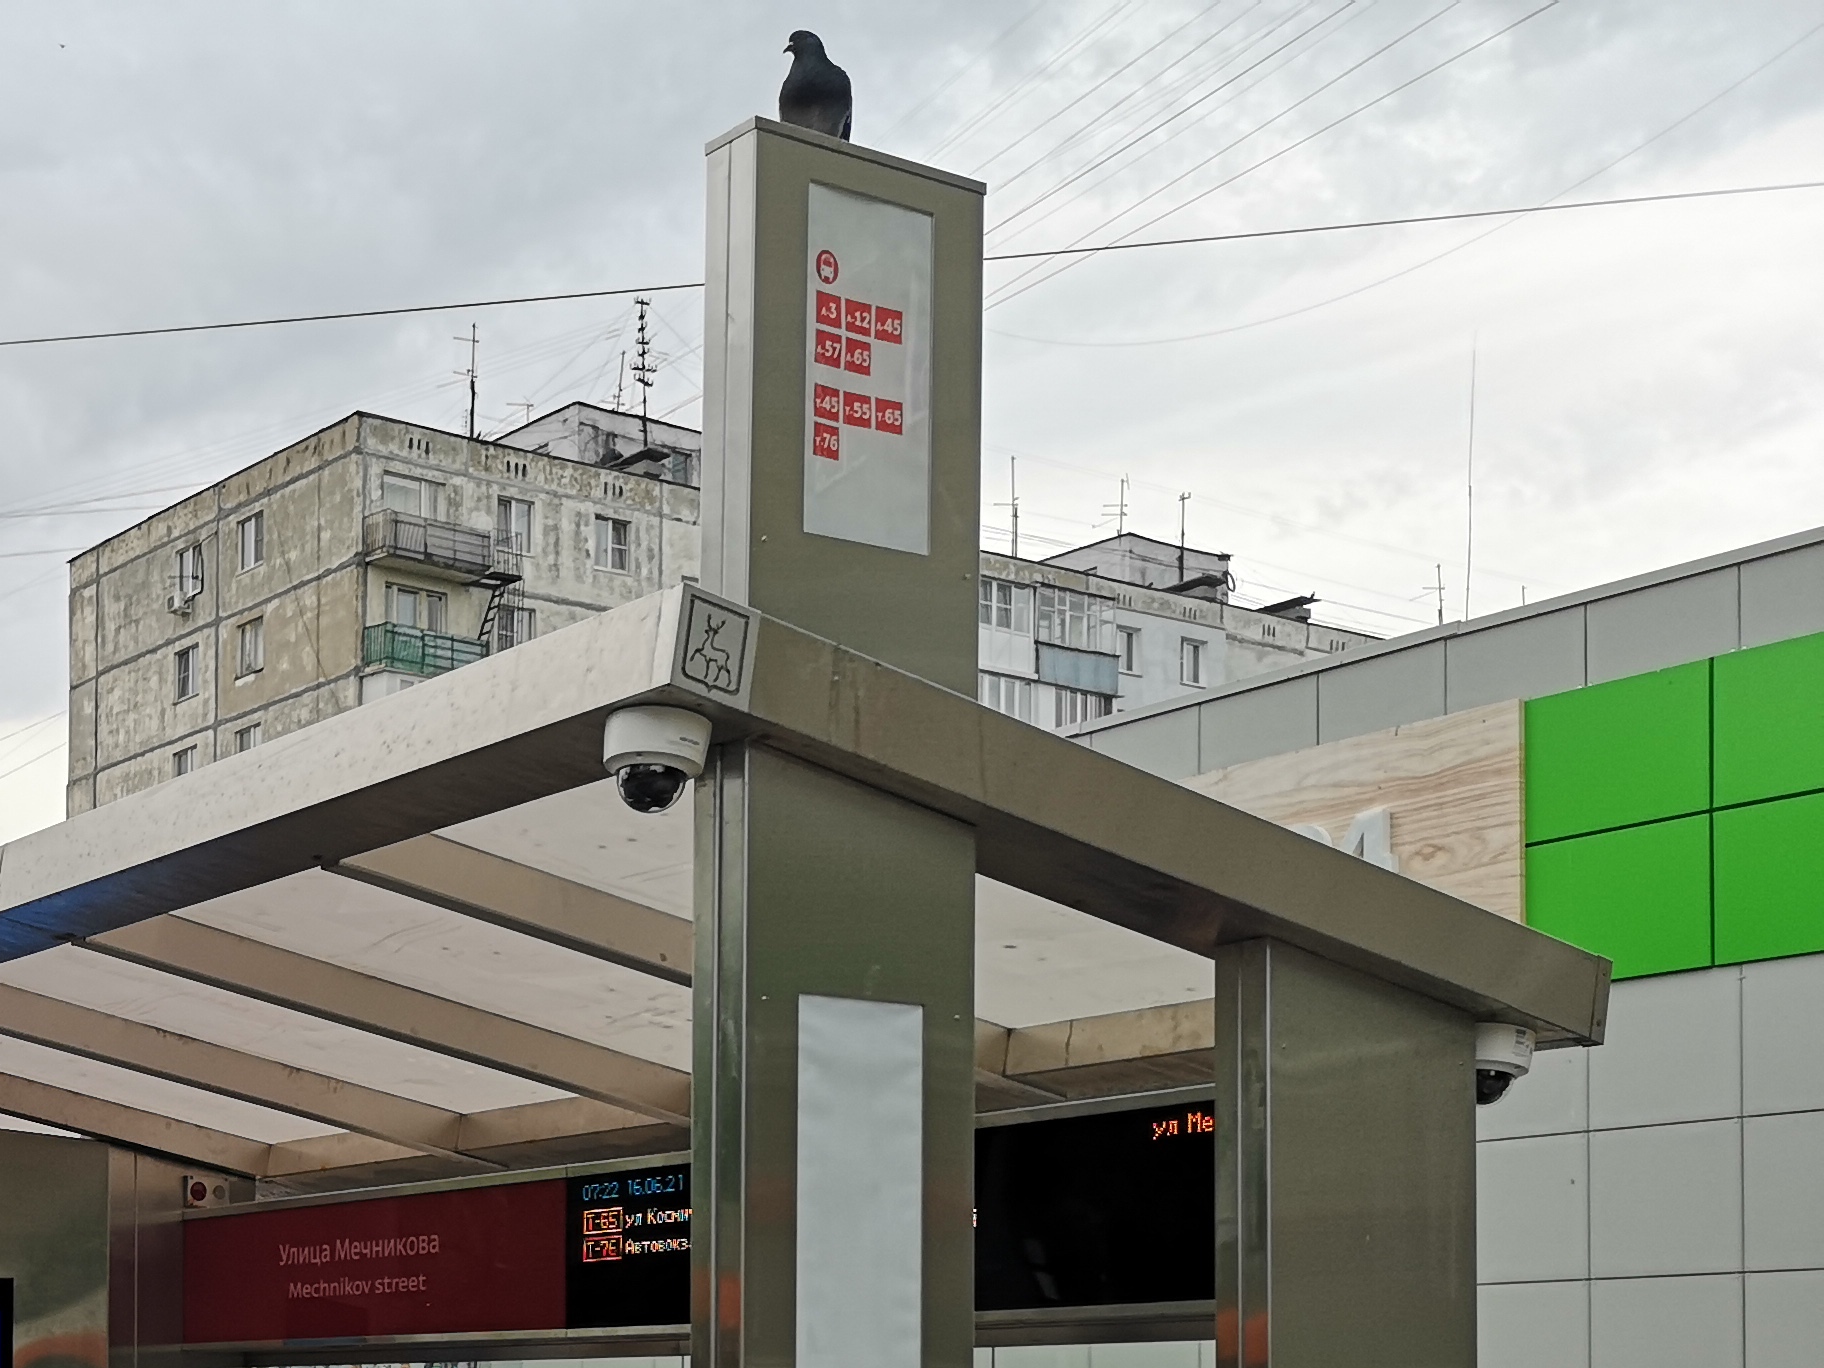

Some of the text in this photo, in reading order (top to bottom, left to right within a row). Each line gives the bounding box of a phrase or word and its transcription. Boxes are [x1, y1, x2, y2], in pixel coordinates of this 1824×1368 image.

[1152, 1120, 1178, 1140] ул
[625, 1213, 643, 1229] ул
[278, 1234, 440, 1267] Улица Мечникова
[288, 1273, 427, 1299] Mechnikov street
